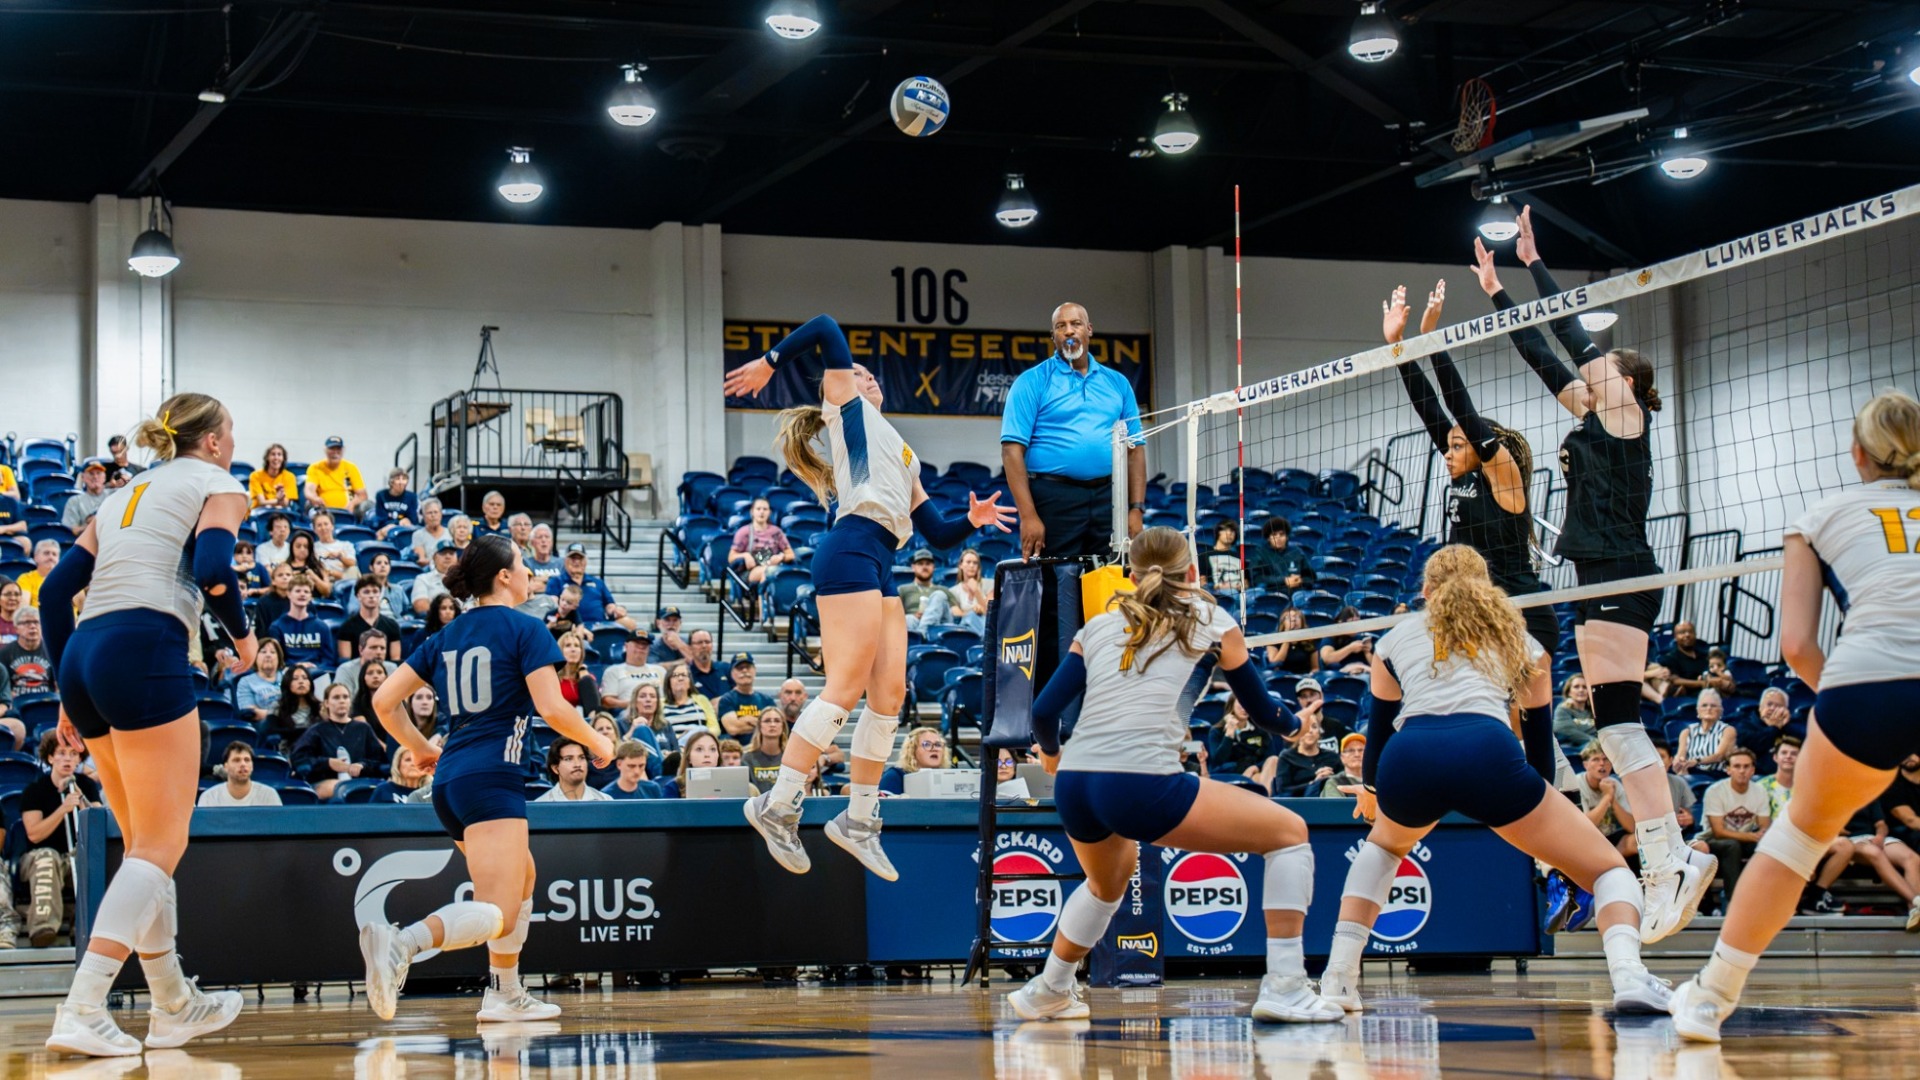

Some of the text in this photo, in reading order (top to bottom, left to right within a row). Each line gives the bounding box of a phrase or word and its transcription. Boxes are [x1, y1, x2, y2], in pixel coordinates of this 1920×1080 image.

[916, 82, 946, 98] molten
[1705, 194, 1896, 268] LUMBERJACKS
[891, 266, 969, 326] 106
[1444, 287, 1587, 344] LUMBERJACKS
[724, 325, 1141, 364] STENT SECTON
[1238, 357, 1353, 403] LUMBERJACKS
[120, 481, 152, 529] 1
[284, 632, 321, 645] NAU
[1005, 644, 1032, 664] NAU
[441, 645, 492, 716] 10
[1170, 887, 1242, 905] PEPSI
[1388, 886, 1426, 904] PSI
[580, 924, 654, 943] LIVE FIT
[1121, 939, 1153, 950] NAU
[1186, 943, 1234, 955] EST. 1943
[1372, 941, 1418, 953] EST. 1943
